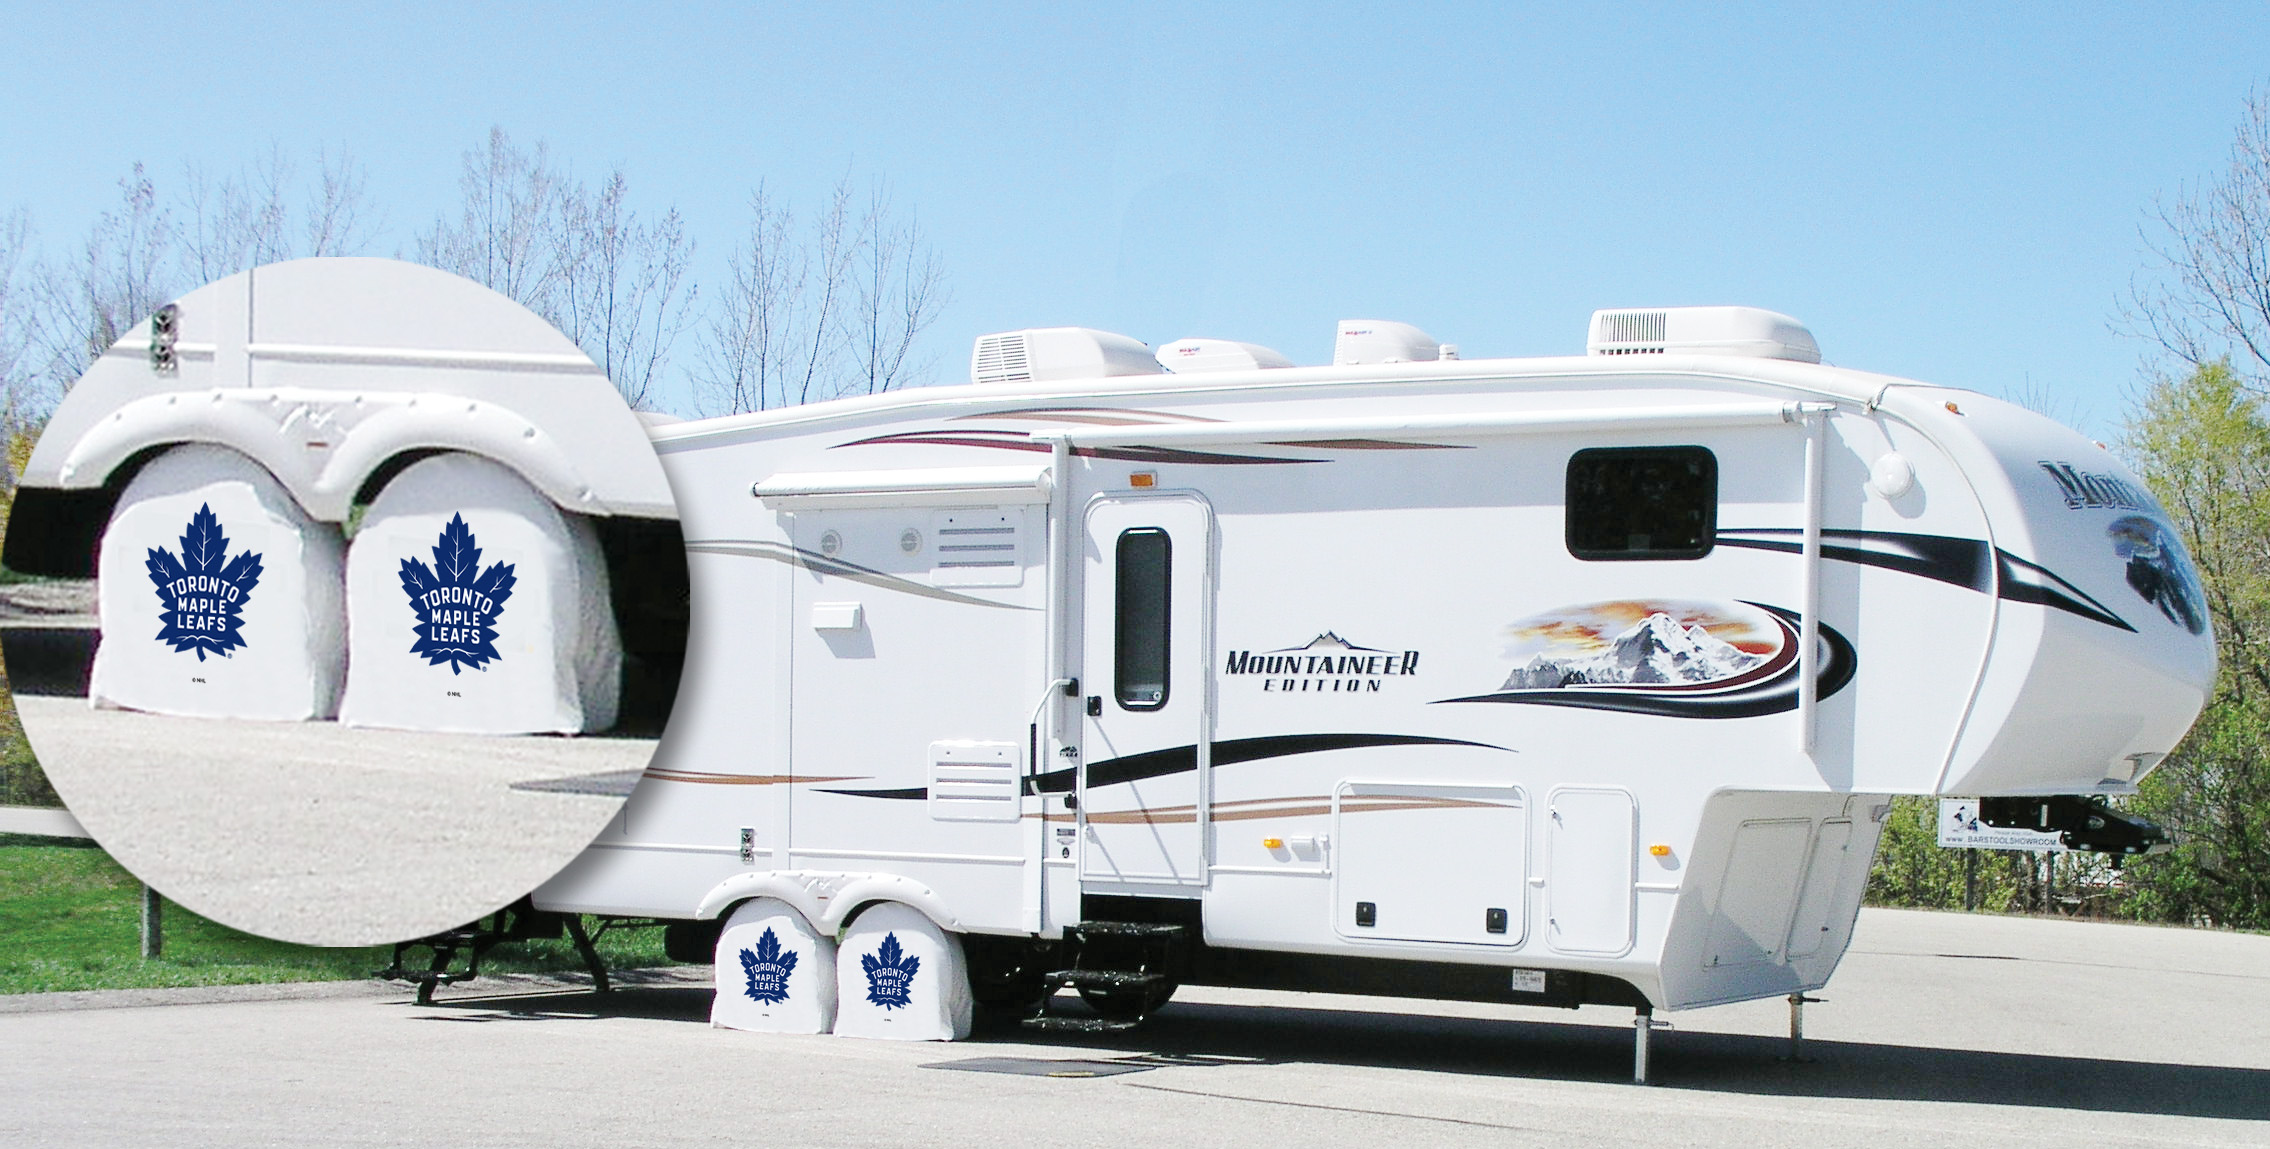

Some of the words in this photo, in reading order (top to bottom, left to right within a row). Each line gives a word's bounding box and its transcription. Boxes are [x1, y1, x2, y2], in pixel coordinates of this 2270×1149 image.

[166, 575, 240, 603] TORONTO
[177, 597, 227, 614] MAPLE
[419, 586, 493, 615] TORONTO
[177, 613, 226, 632] LEAFS
[431, 608, 481, 626] MAPLE
[431, 626, 481, 645] LEAFS
[1225, 650, 1420, 676] MOUNTAINEER
[1263, 678, 1381, 692] EDITION
[749, 962, 787, 977] TORONTO
[871, 967, 909, 982] TORONTO
[755, 973, 780, 983] MAPLE
[877, 978, 902, 988] MAPLE
[754, 981, 780, 992] LEAFS
[876, 986, 902, 997] LEAFS
